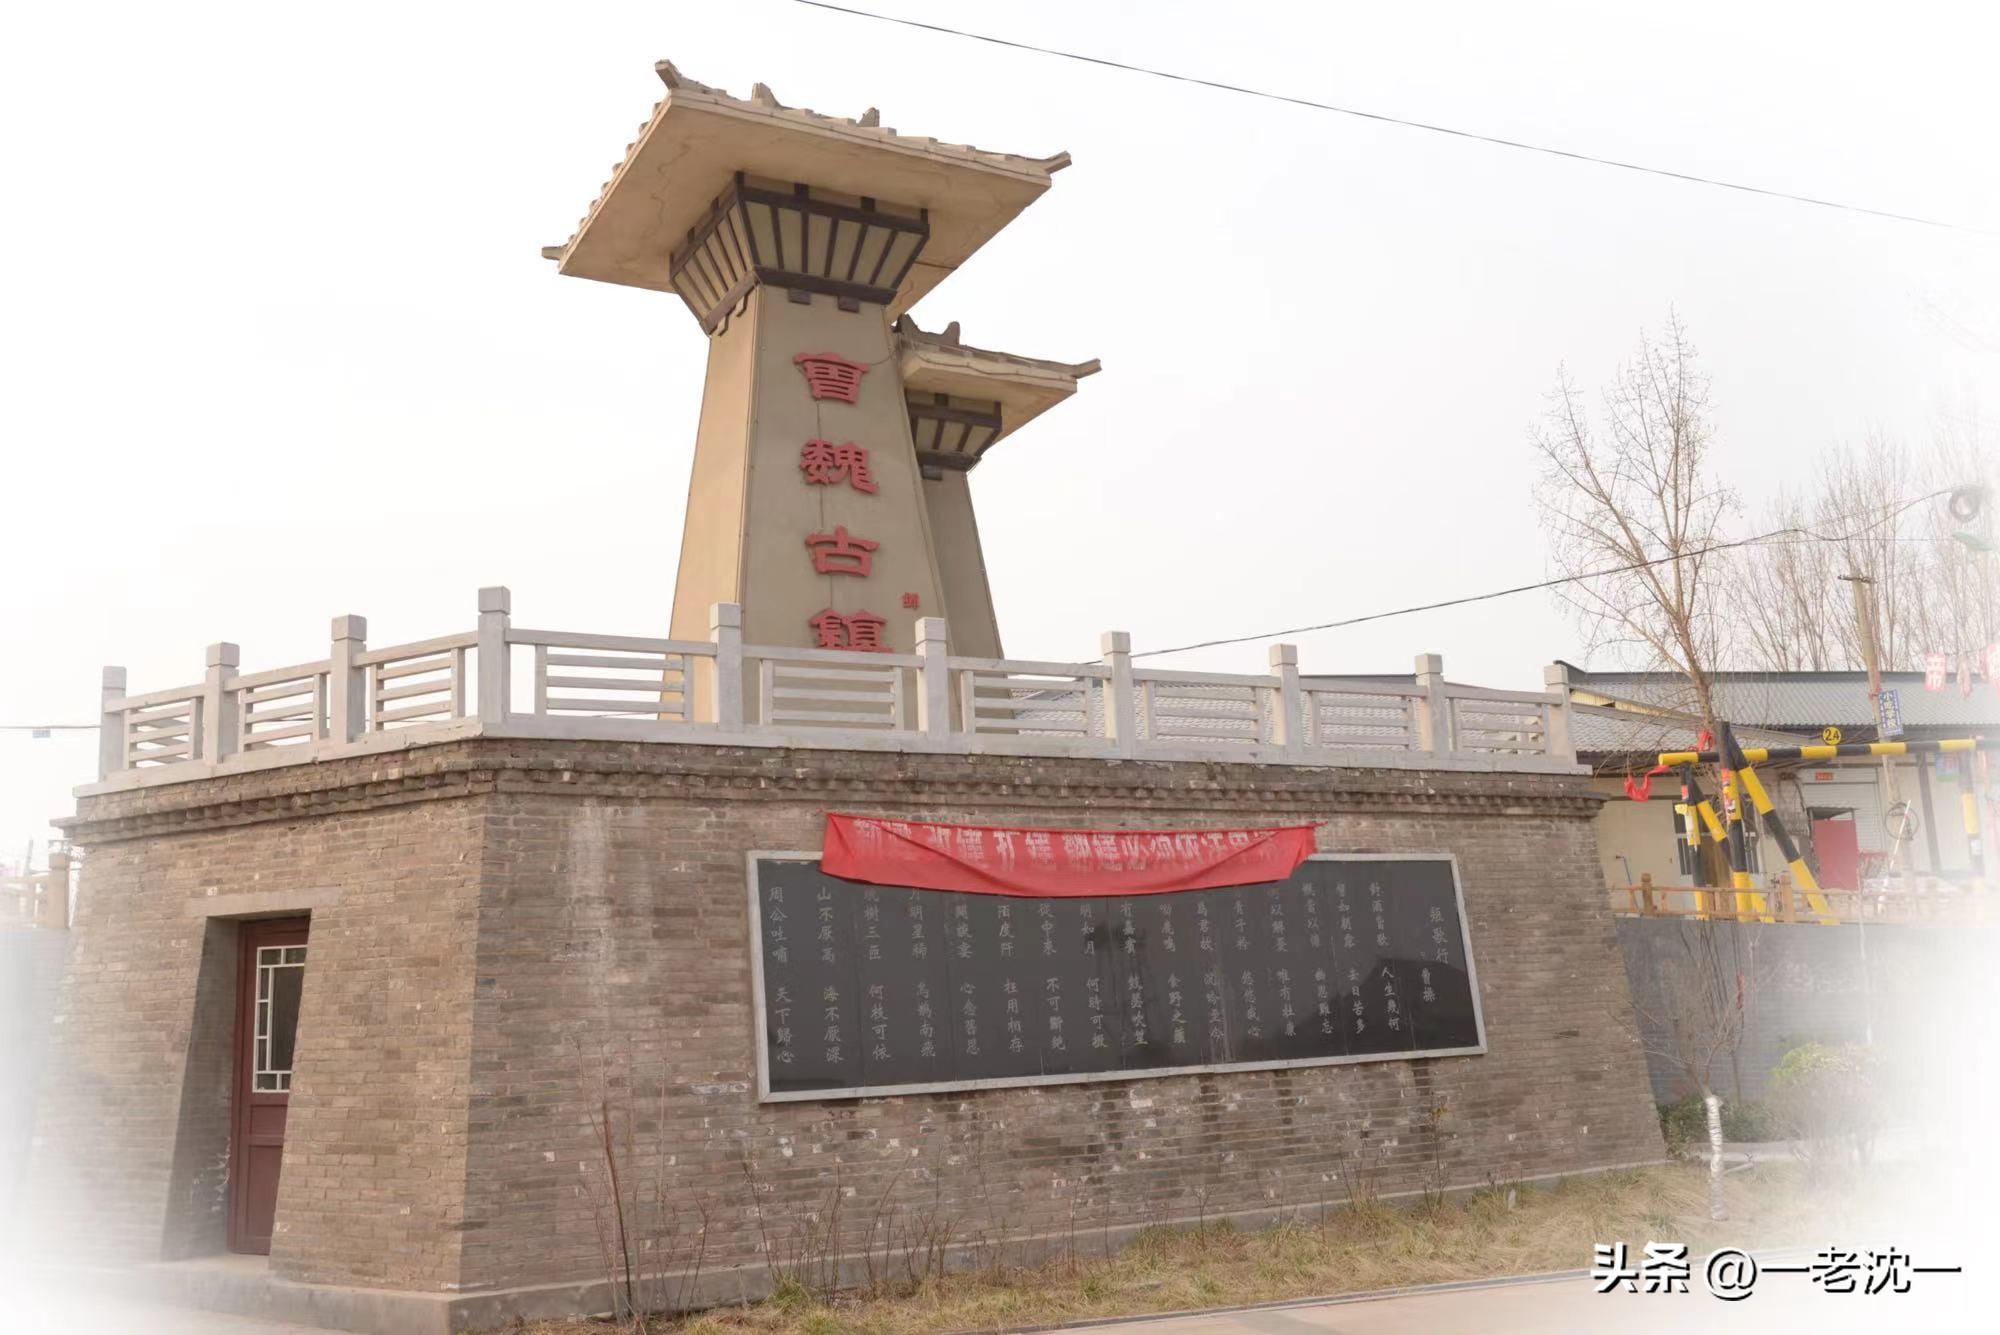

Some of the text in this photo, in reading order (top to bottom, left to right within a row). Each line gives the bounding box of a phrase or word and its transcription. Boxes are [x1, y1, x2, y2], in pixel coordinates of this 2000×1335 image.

[769, 886, 795, 1063] 周公吐哺 天下歸心
[1080, 903, 1098, 956] 明如月
